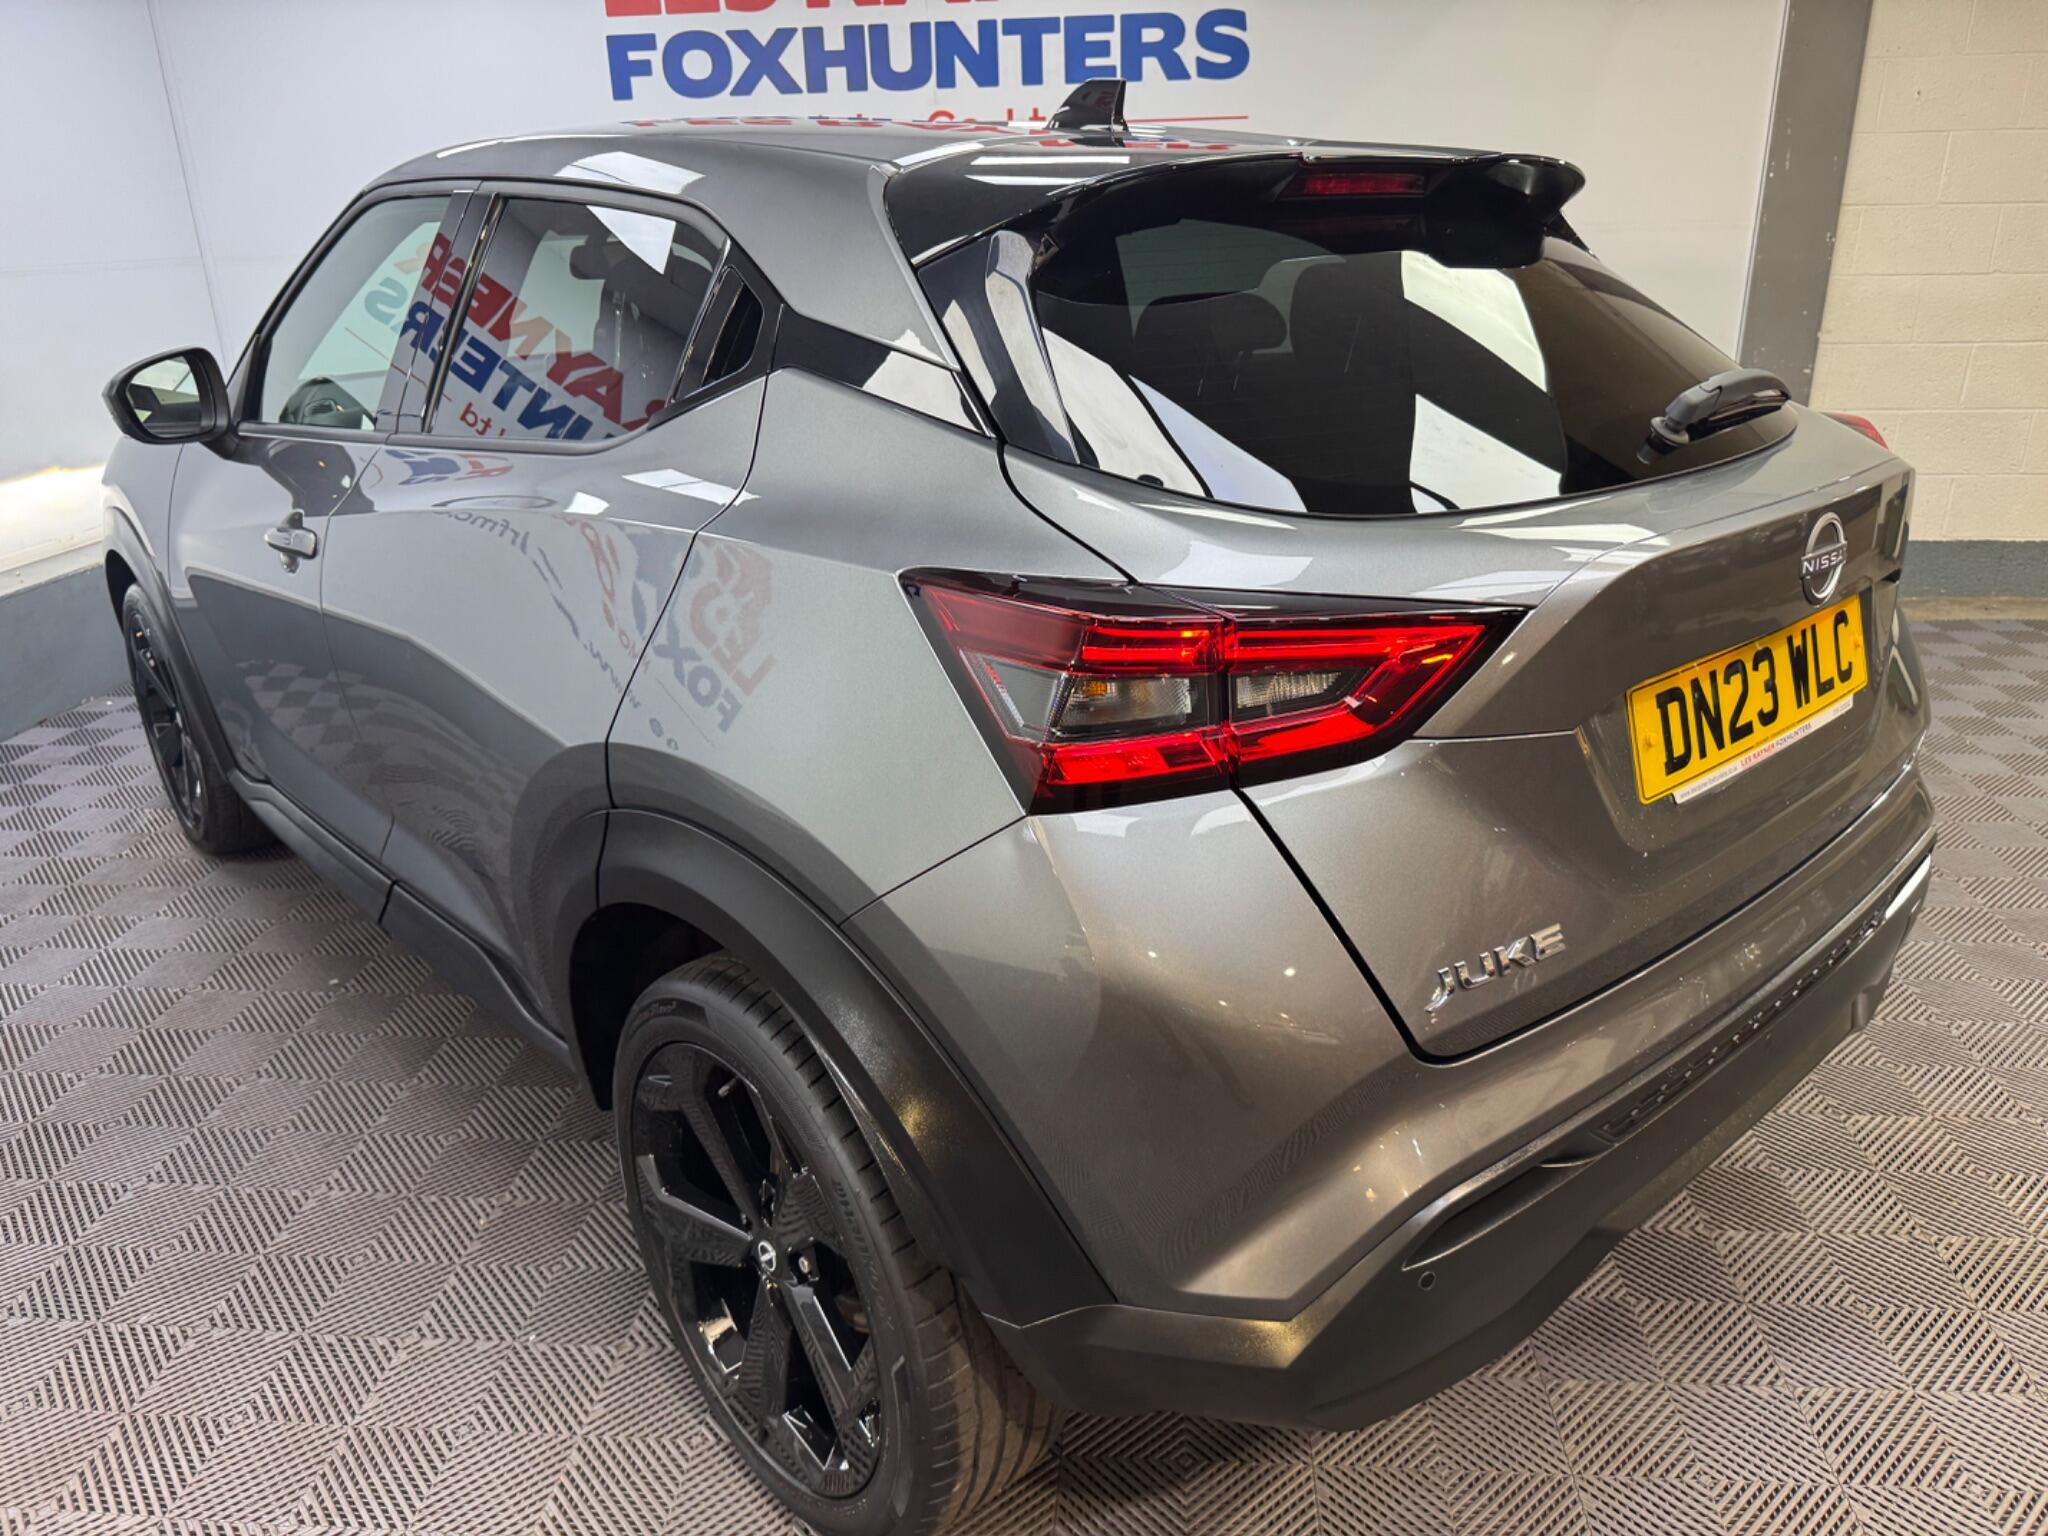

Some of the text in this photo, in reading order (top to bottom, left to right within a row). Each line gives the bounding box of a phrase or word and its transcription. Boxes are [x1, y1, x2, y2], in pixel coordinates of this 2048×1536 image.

[605, 9, 1250, 100] FOXHUNTERS
[1655, 609, 1853, 776] DN23 WLC
[1424, 922, 1566, 1013] JUKE
